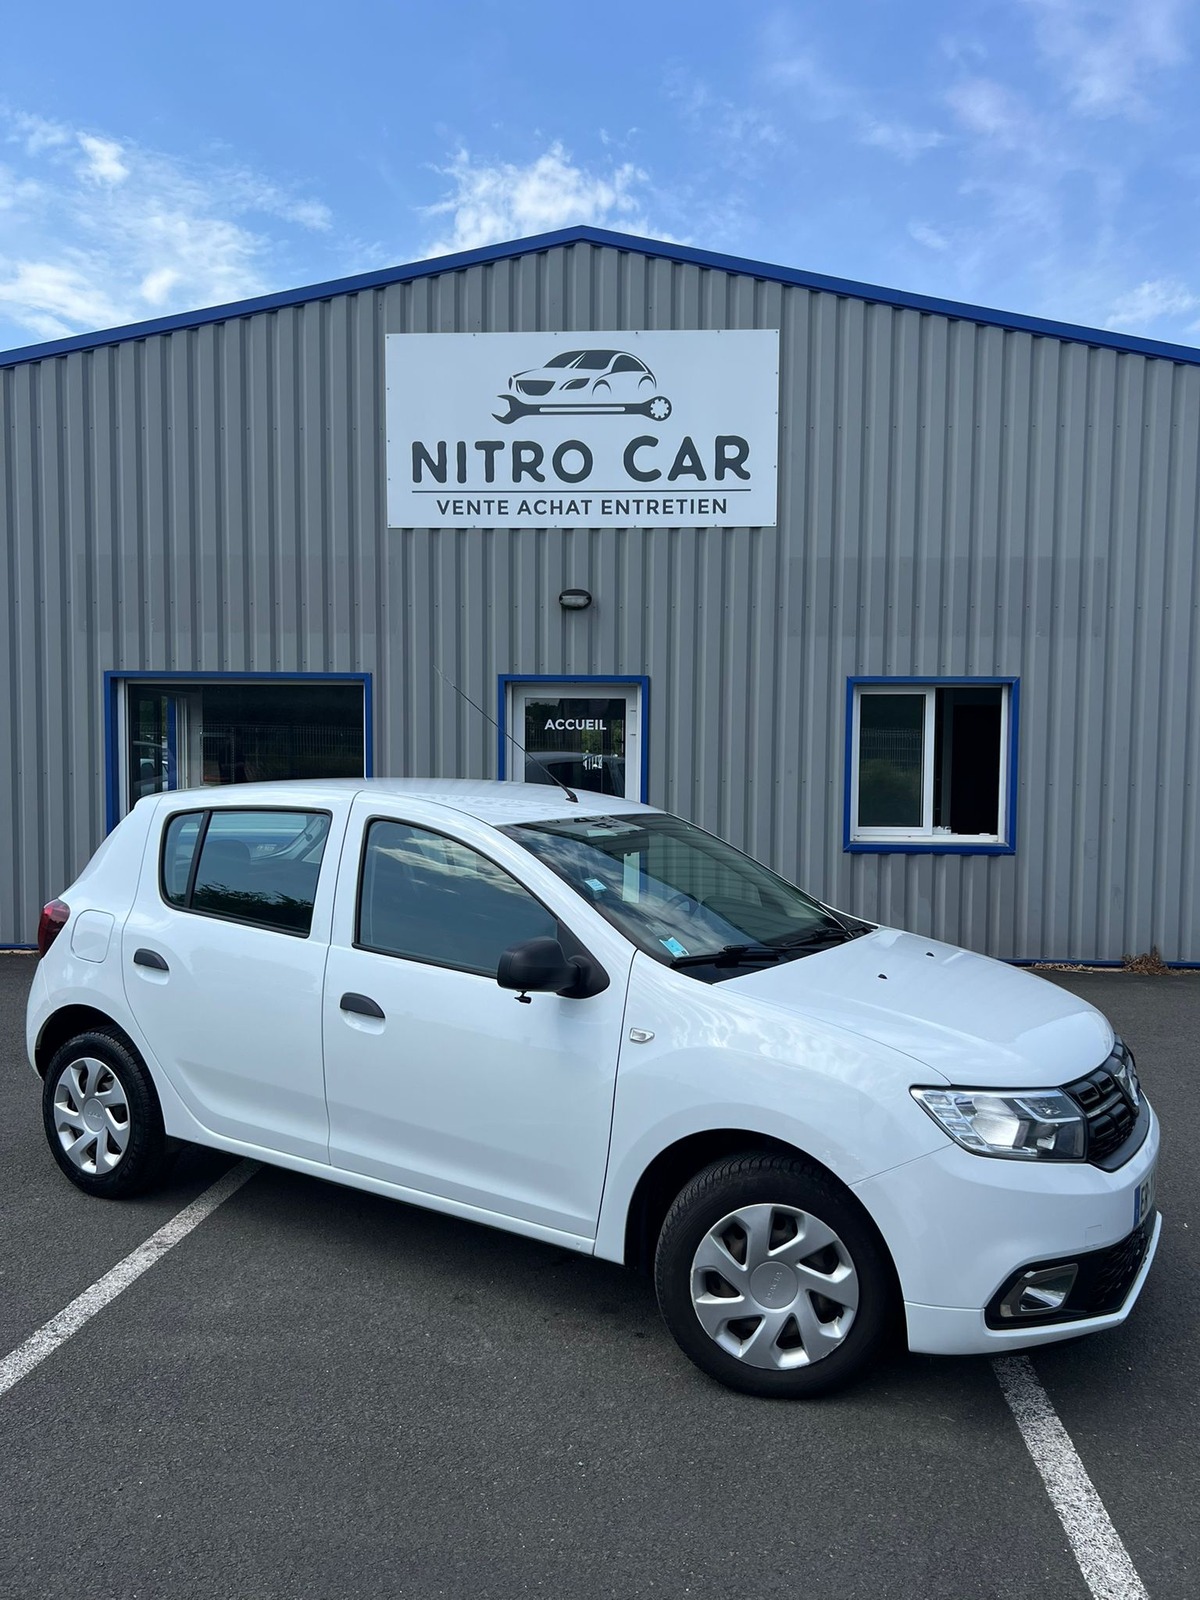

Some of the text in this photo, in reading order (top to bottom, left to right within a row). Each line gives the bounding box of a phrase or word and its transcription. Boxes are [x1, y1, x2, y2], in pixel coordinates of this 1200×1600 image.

[411, 434, 751, 484] NITRO CAR
[436, 498, 727, 516] VENTE ACHAT ENTRETIEN
[544, 718, 607, 731] ACCUEIL
